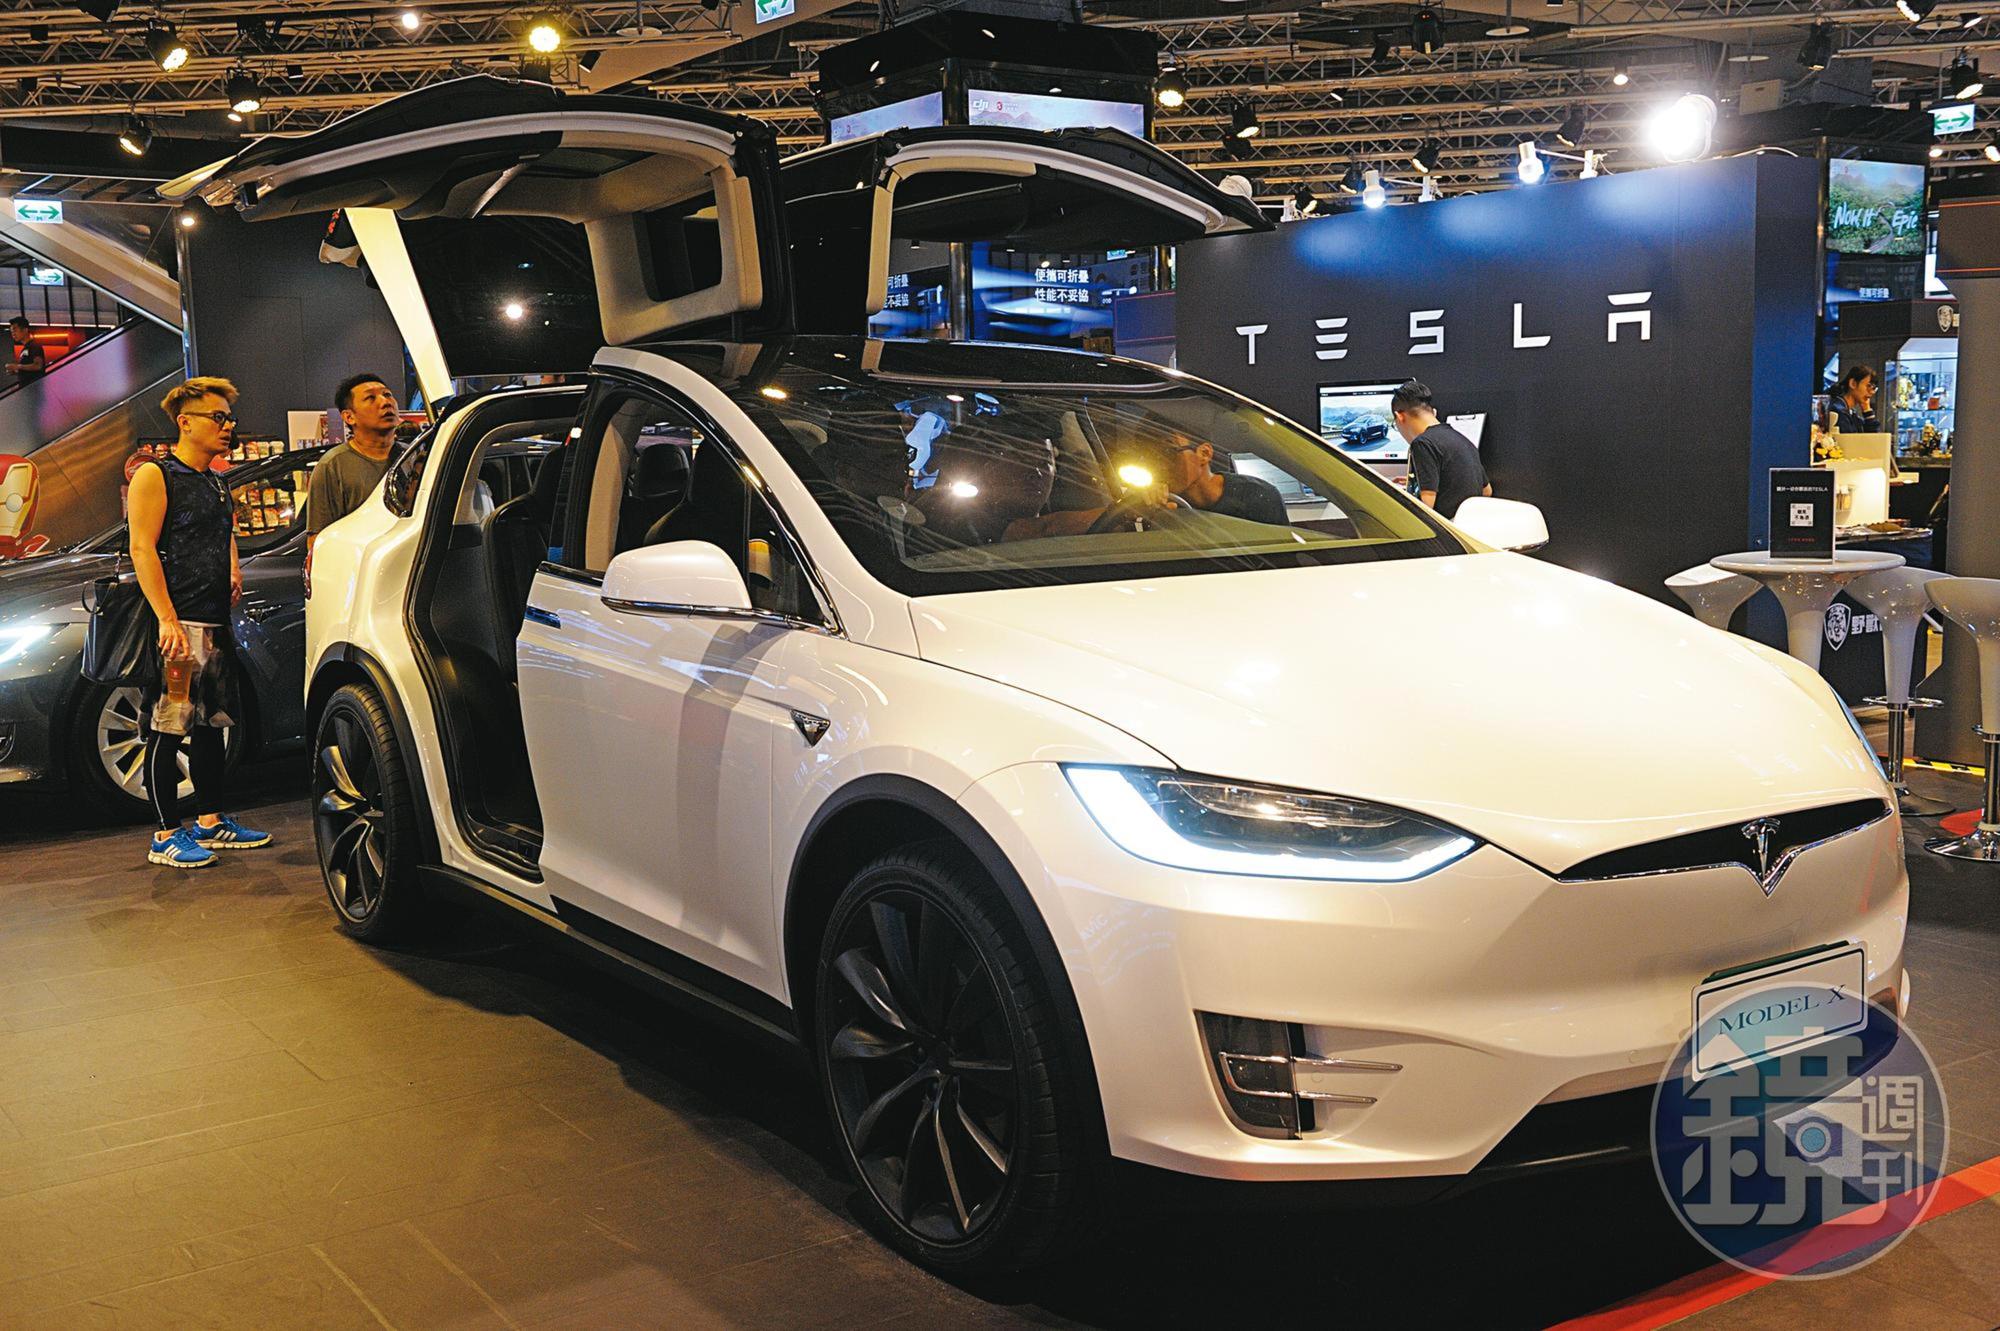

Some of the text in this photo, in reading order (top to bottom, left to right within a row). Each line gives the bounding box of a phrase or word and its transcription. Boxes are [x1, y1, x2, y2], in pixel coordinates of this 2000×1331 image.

[1892, 210, 1918, 236] Epic
[1035, 268, 1089, 284] 便攜可折疊
[1035, 288, 1089, 303] 性能不妥協
[1236, 291, 1652, 365] TESLA
[1851, 614, 1883, 635] 野獸
[1719, 984, 1846, 1035] MODEL X
